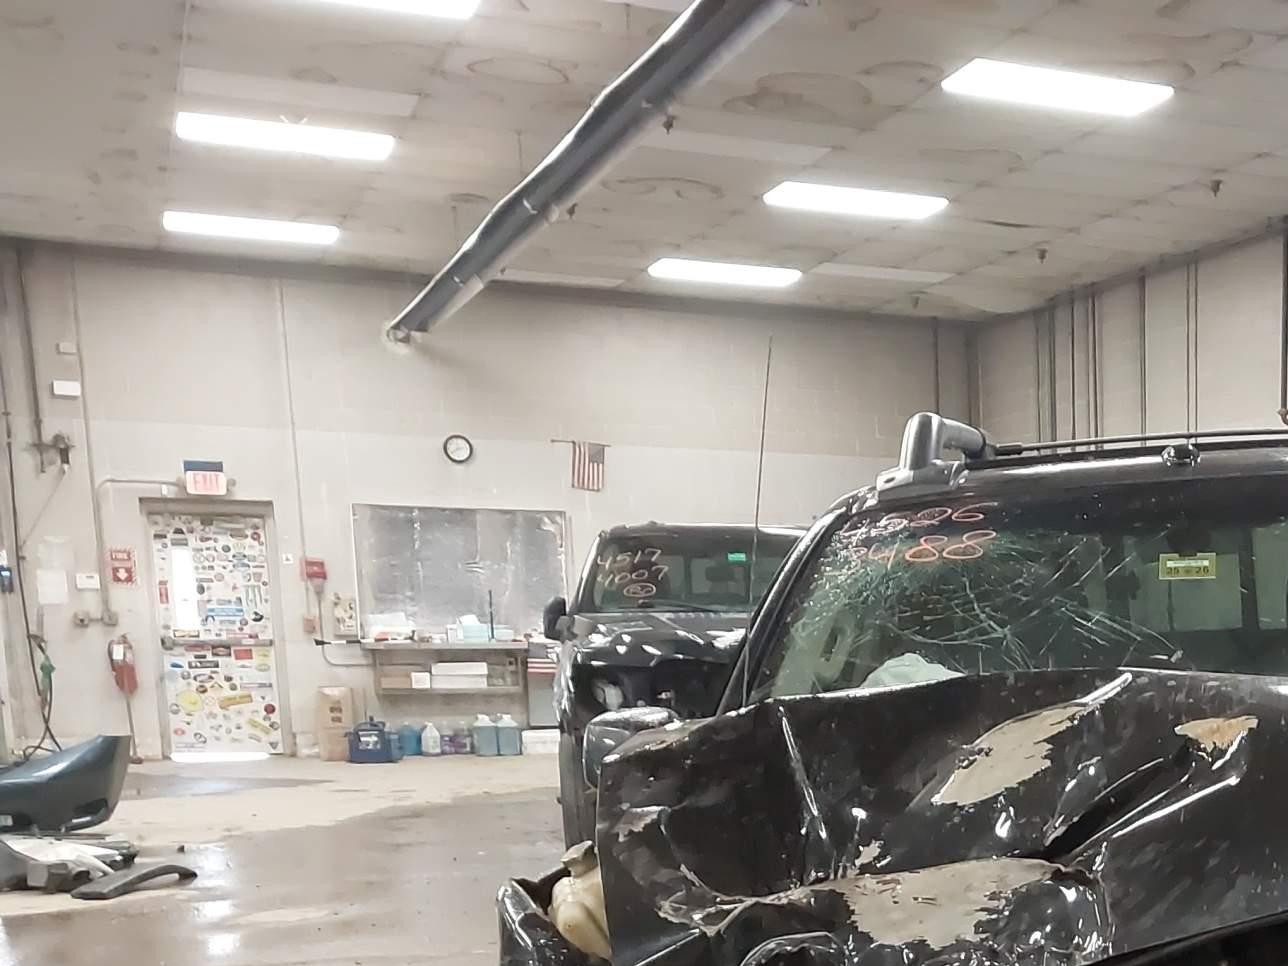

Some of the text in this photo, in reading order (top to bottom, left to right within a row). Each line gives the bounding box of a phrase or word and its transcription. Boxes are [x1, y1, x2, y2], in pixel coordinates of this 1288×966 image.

[193, 472, 220, 492] EXIT
[597, 548, 662, 570] 4517
[597, 565, 669, 588] 4007
